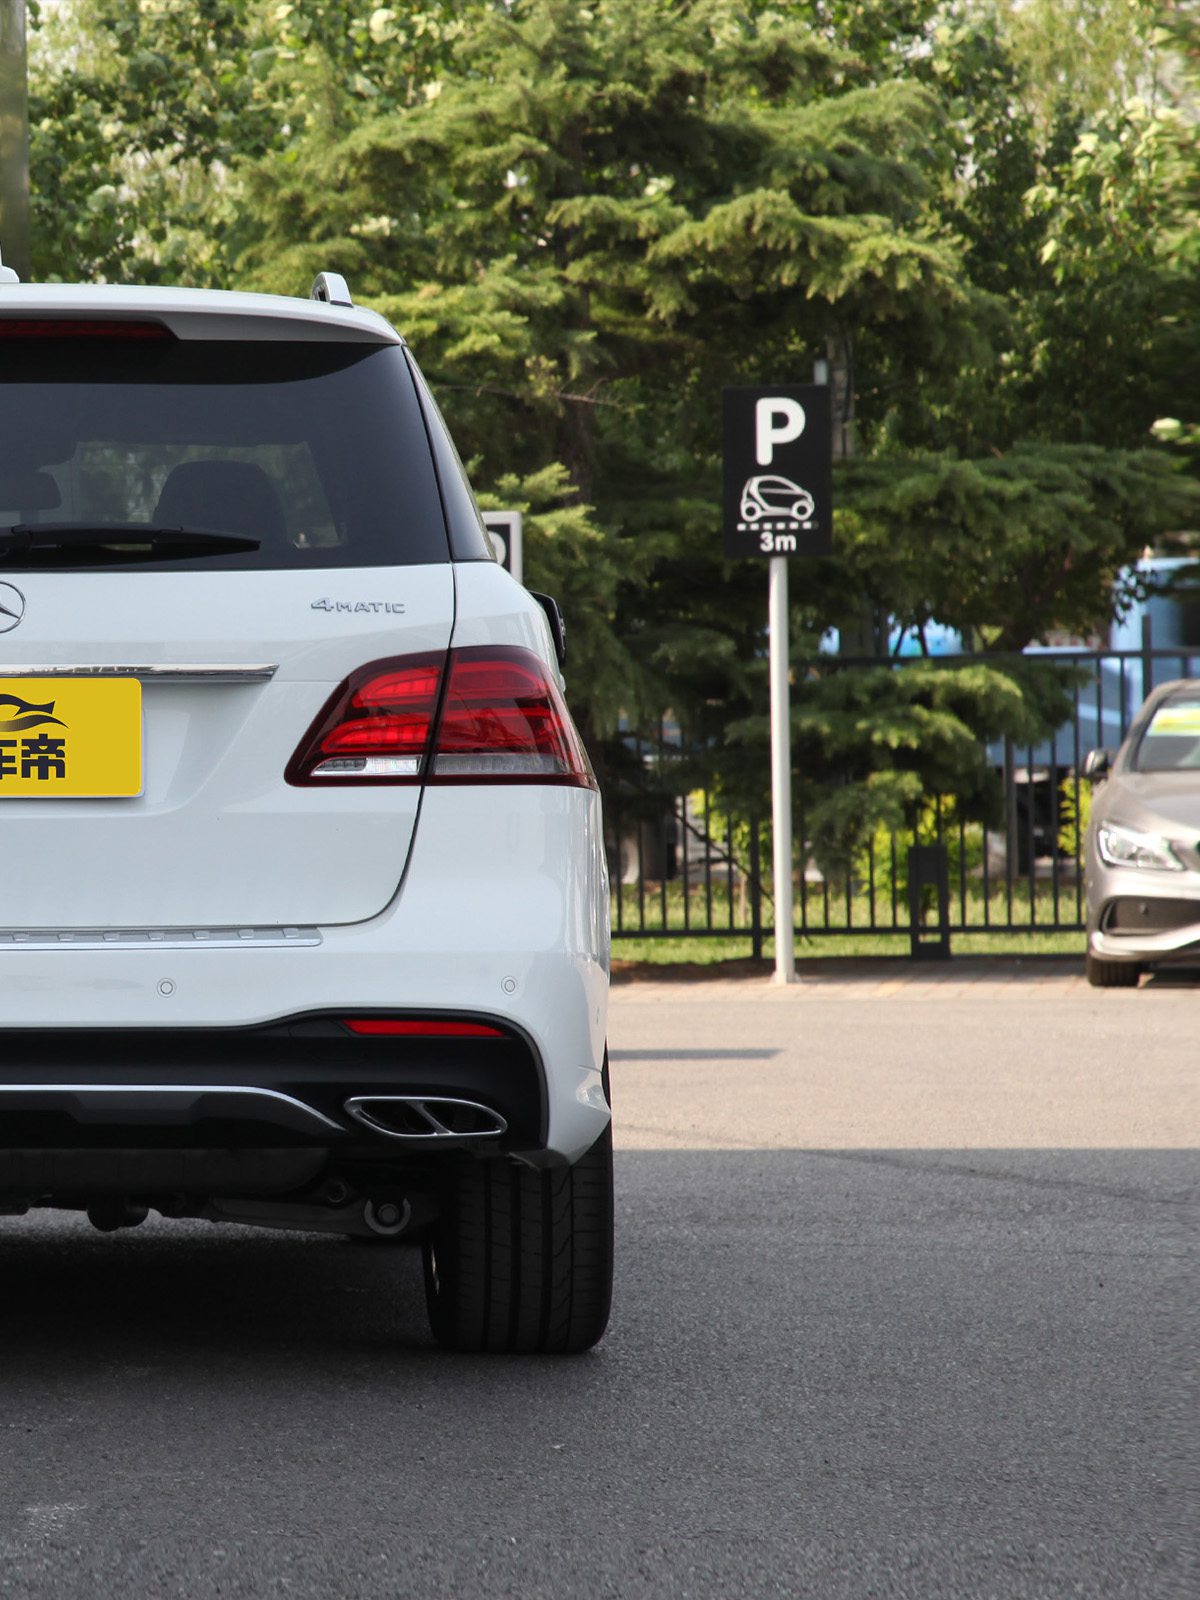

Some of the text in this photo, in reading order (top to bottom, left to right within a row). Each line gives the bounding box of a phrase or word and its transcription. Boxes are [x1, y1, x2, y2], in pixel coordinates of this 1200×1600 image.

[756, 397, 806, 466] P
[760, 531, 797, 552] 3m
[310, 597, 406, 614] 4MATIC
